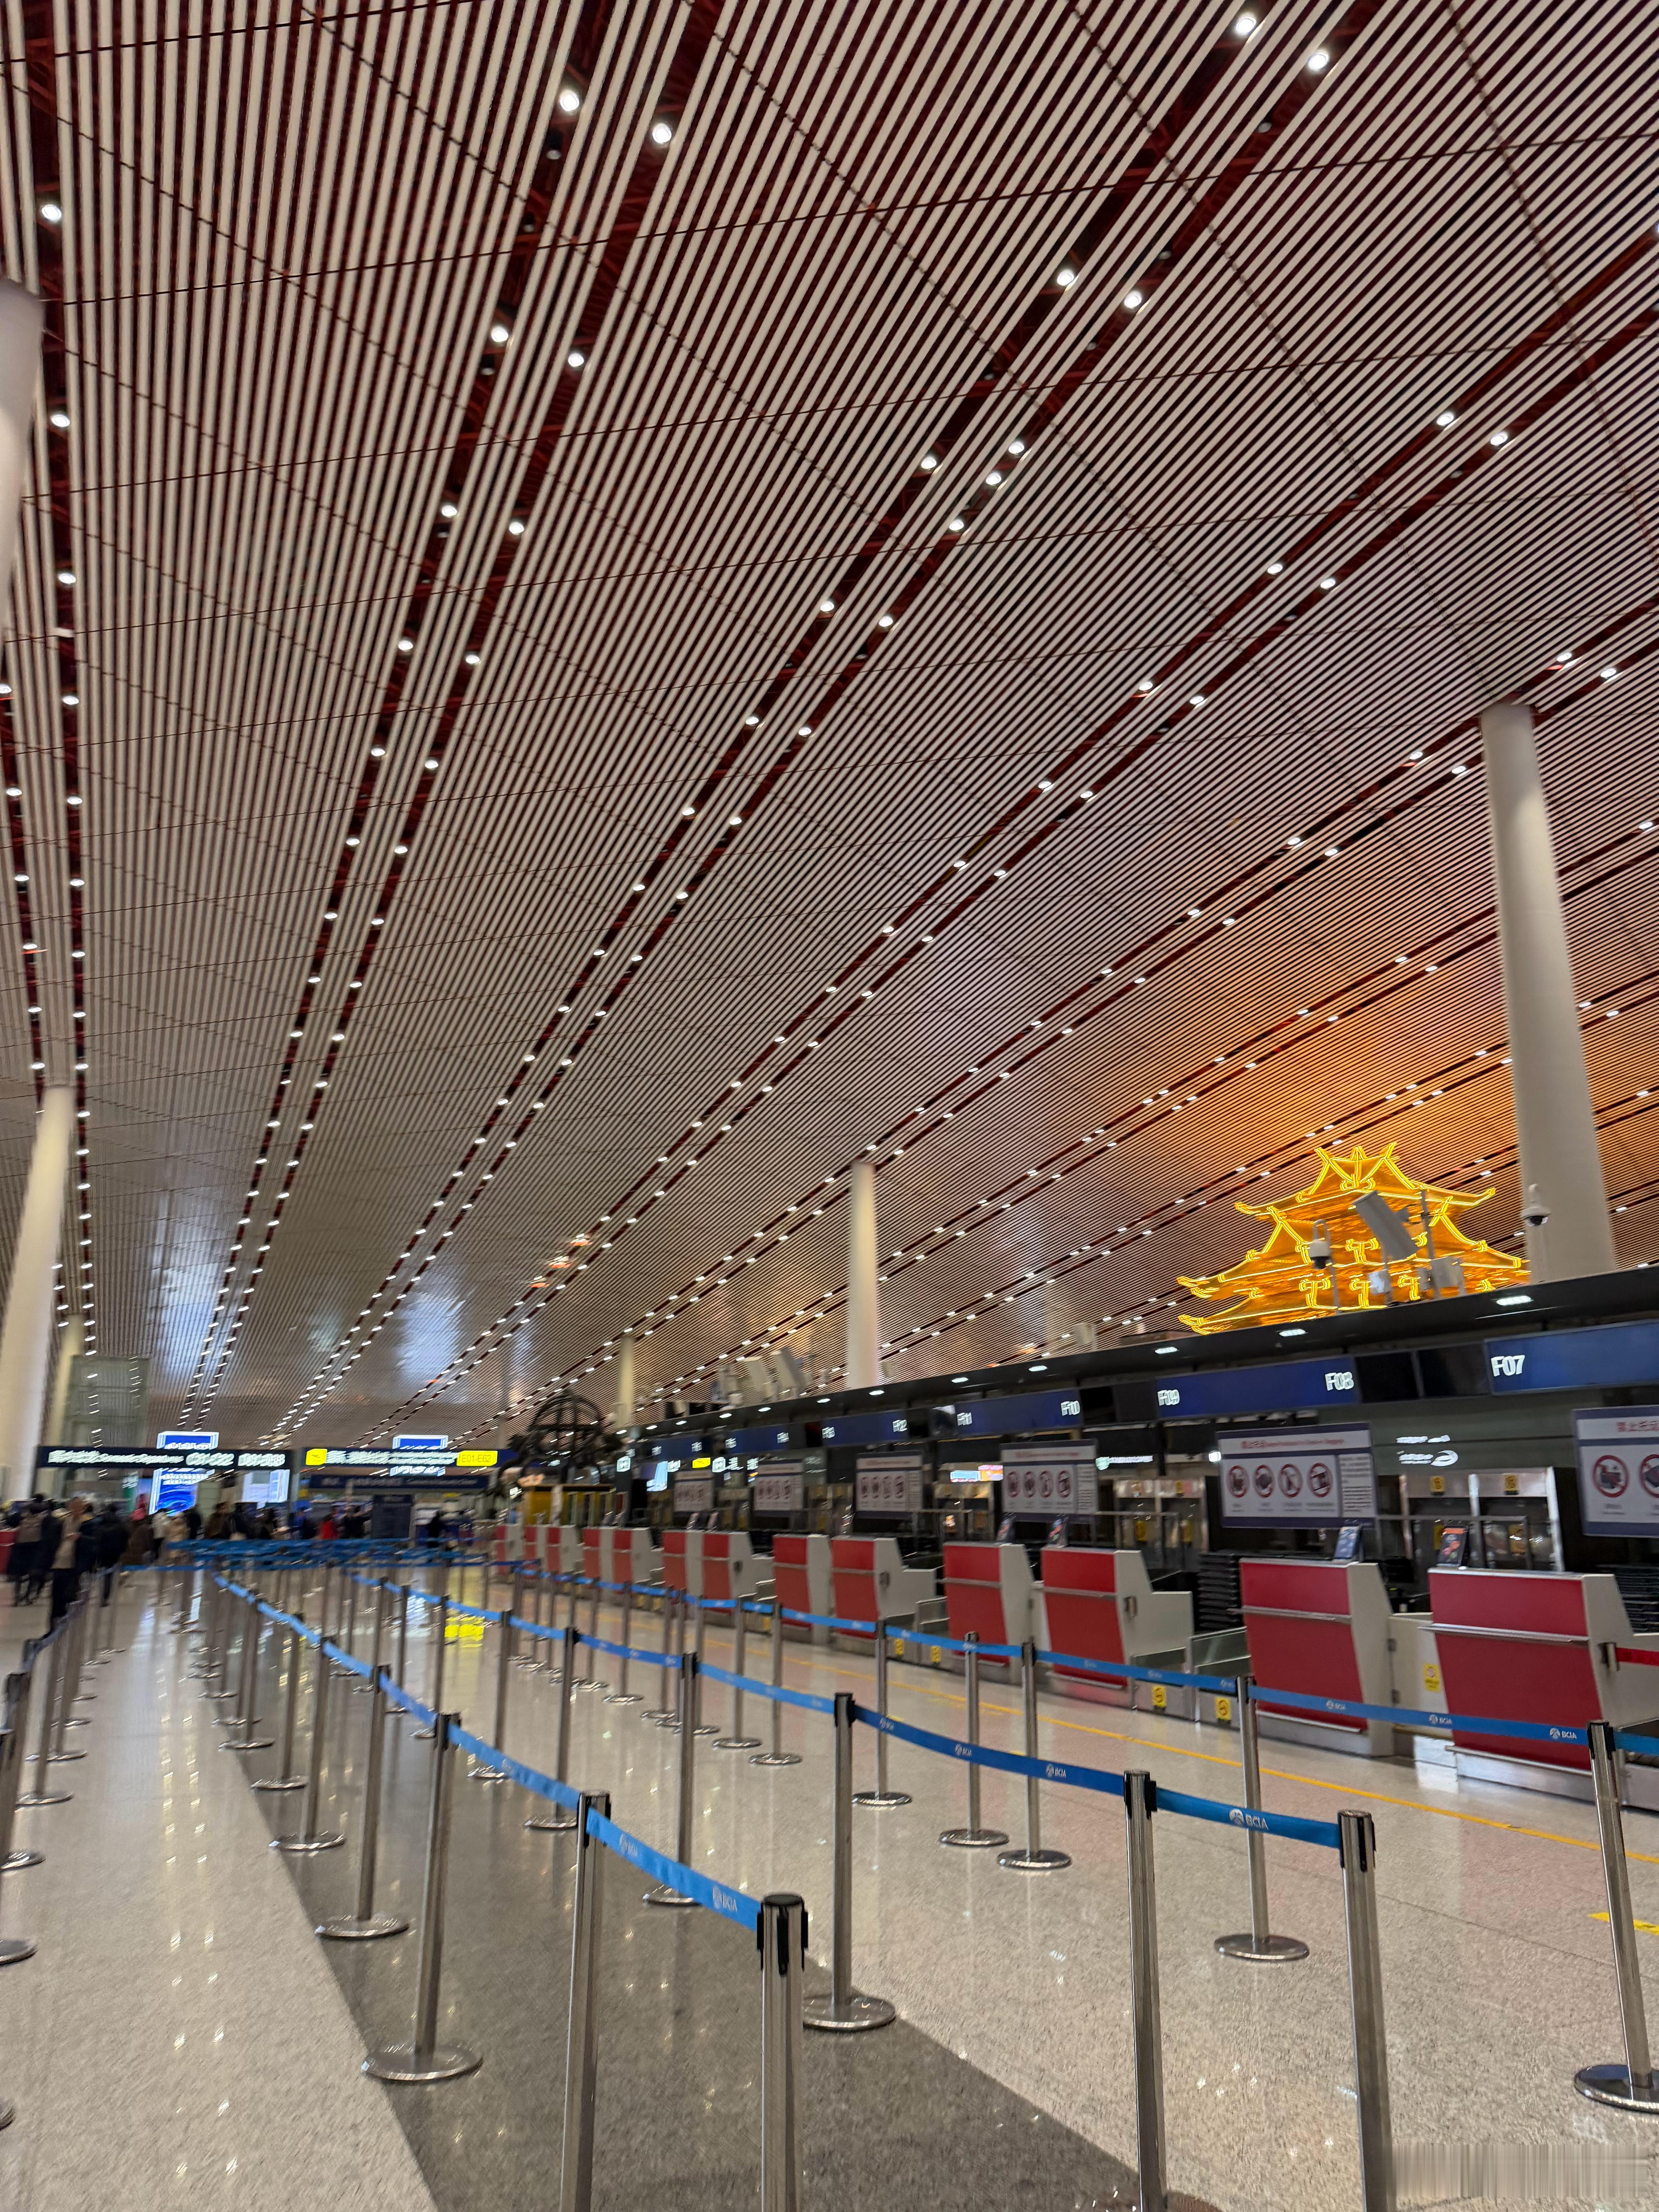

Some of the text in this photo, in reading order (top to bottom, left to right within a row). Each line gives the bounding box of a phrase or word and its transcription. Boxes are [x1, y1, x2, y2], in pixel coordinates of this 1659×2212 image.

[1491, 1355, 1525, 1376] F07
[1325, 1372, 1354, 1391] F08
[1158, 1389, 1180, 1406] F09
[1061, 1401, 1080, 1416] F10
[893, 1419, 907, 1432] F12
[1561, 1731, 1577, 1739] BCIA
[962, 1748, 972, 1756] BCIA
[1053, 1767, 1066, 1778] BCIA
[1245, 1813, 1269, 1830] BCIA
[723, 1893, 738, 1912] BCIA
